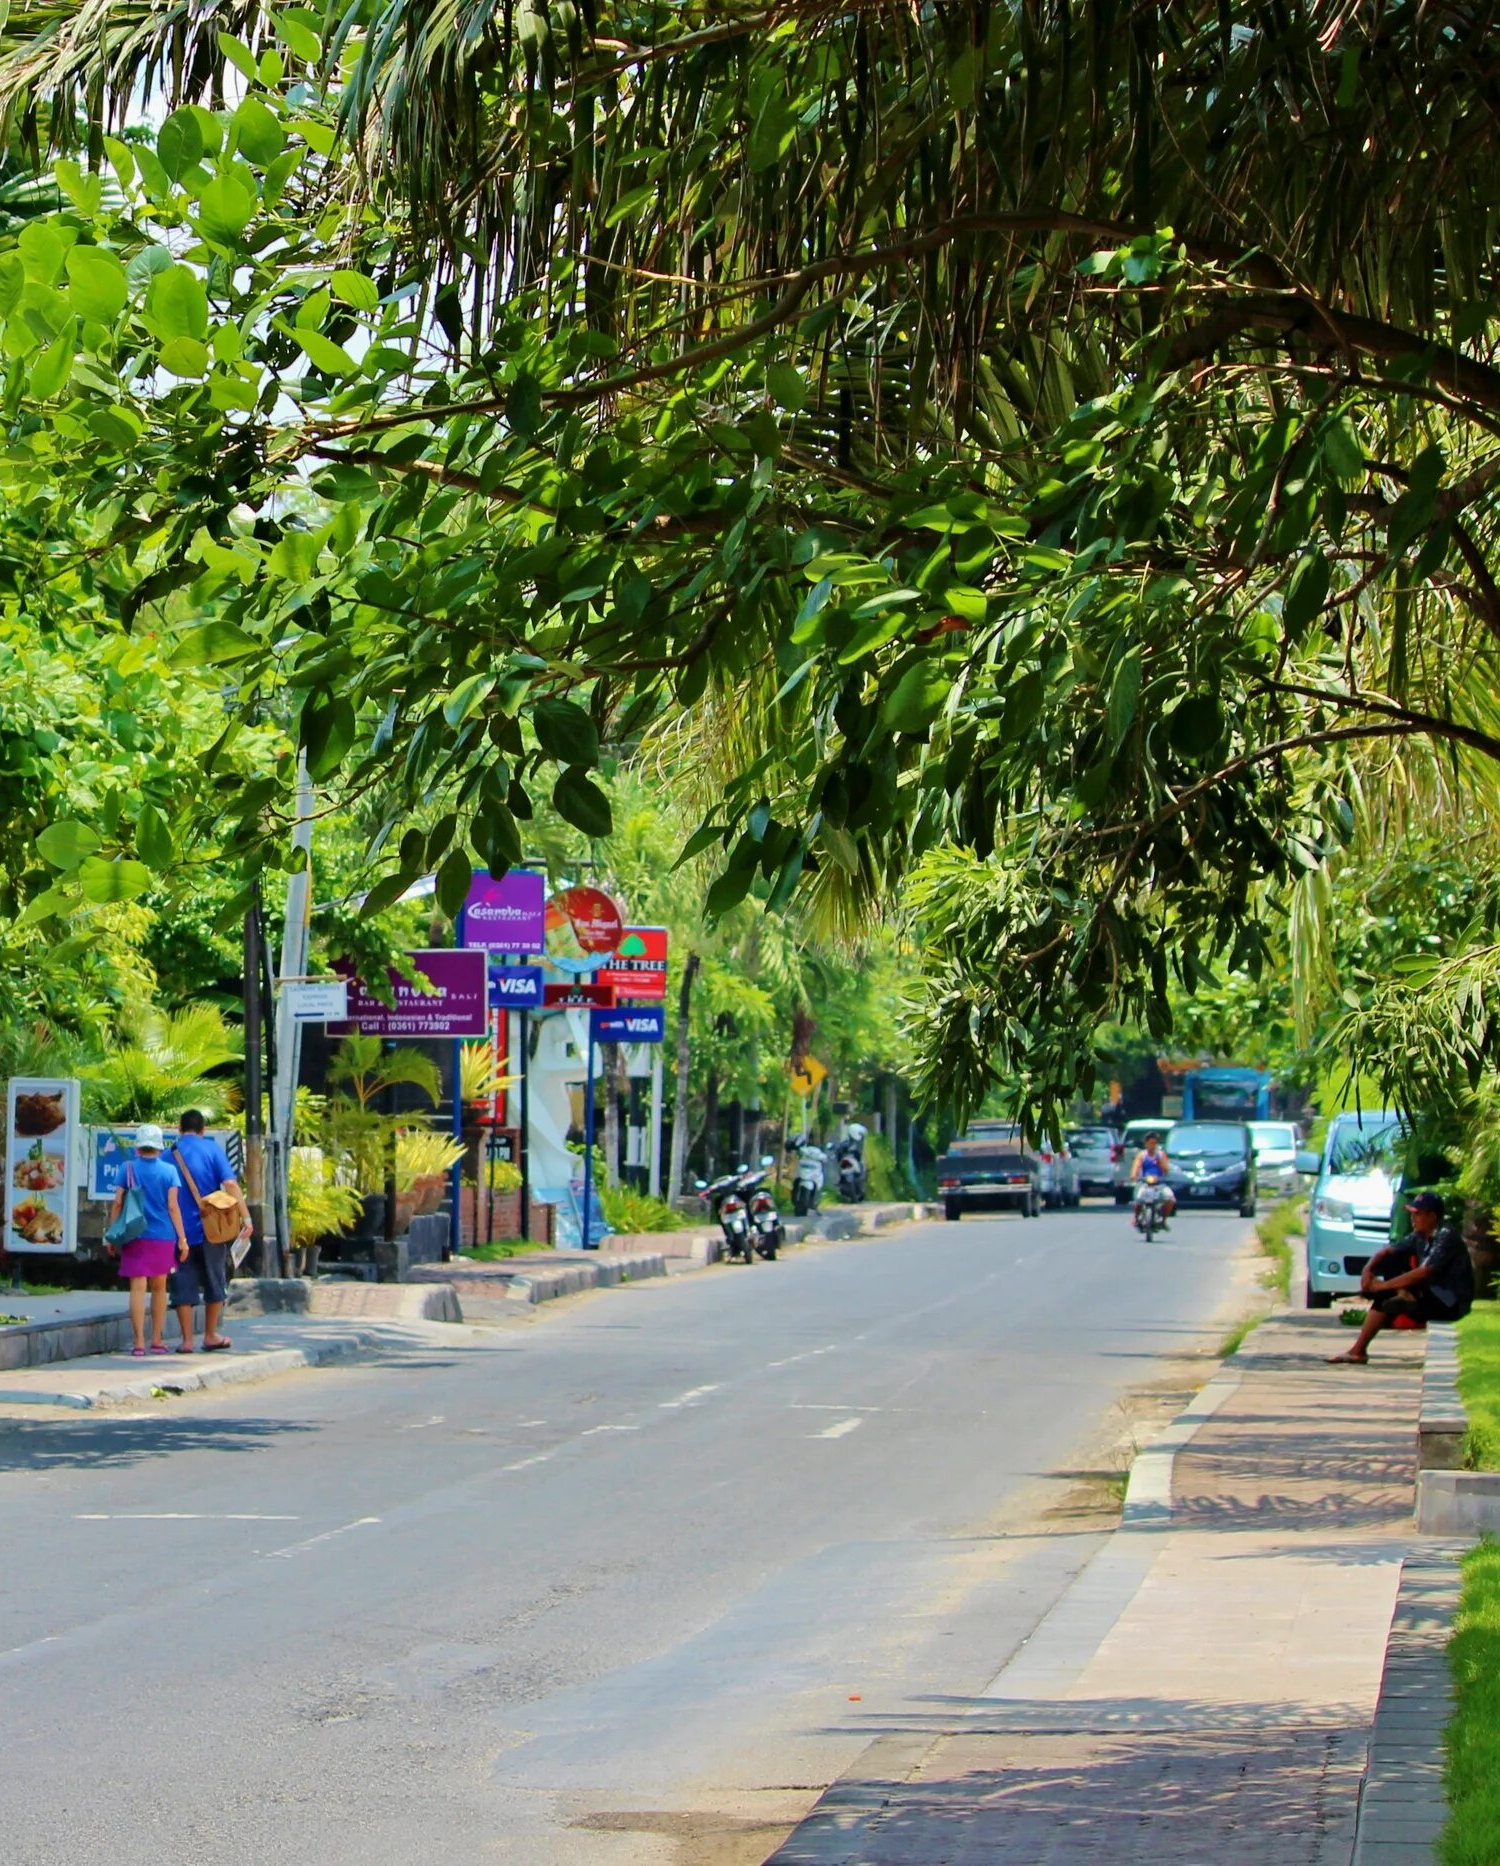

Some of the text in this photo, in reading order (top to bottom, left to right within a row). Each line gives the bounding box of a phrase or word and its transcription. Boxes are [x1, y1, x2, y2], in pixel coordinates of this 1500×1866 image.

[467, 902, 522, 919] Casanova
[632, 960, 666, 970] TREE
[497, 977, 537, 994] VISA
[361, 1022, 380, 1030] Call
[388, 1021, 416, 1031] (0361)
[625, 1018, 658, 1032] VISA
